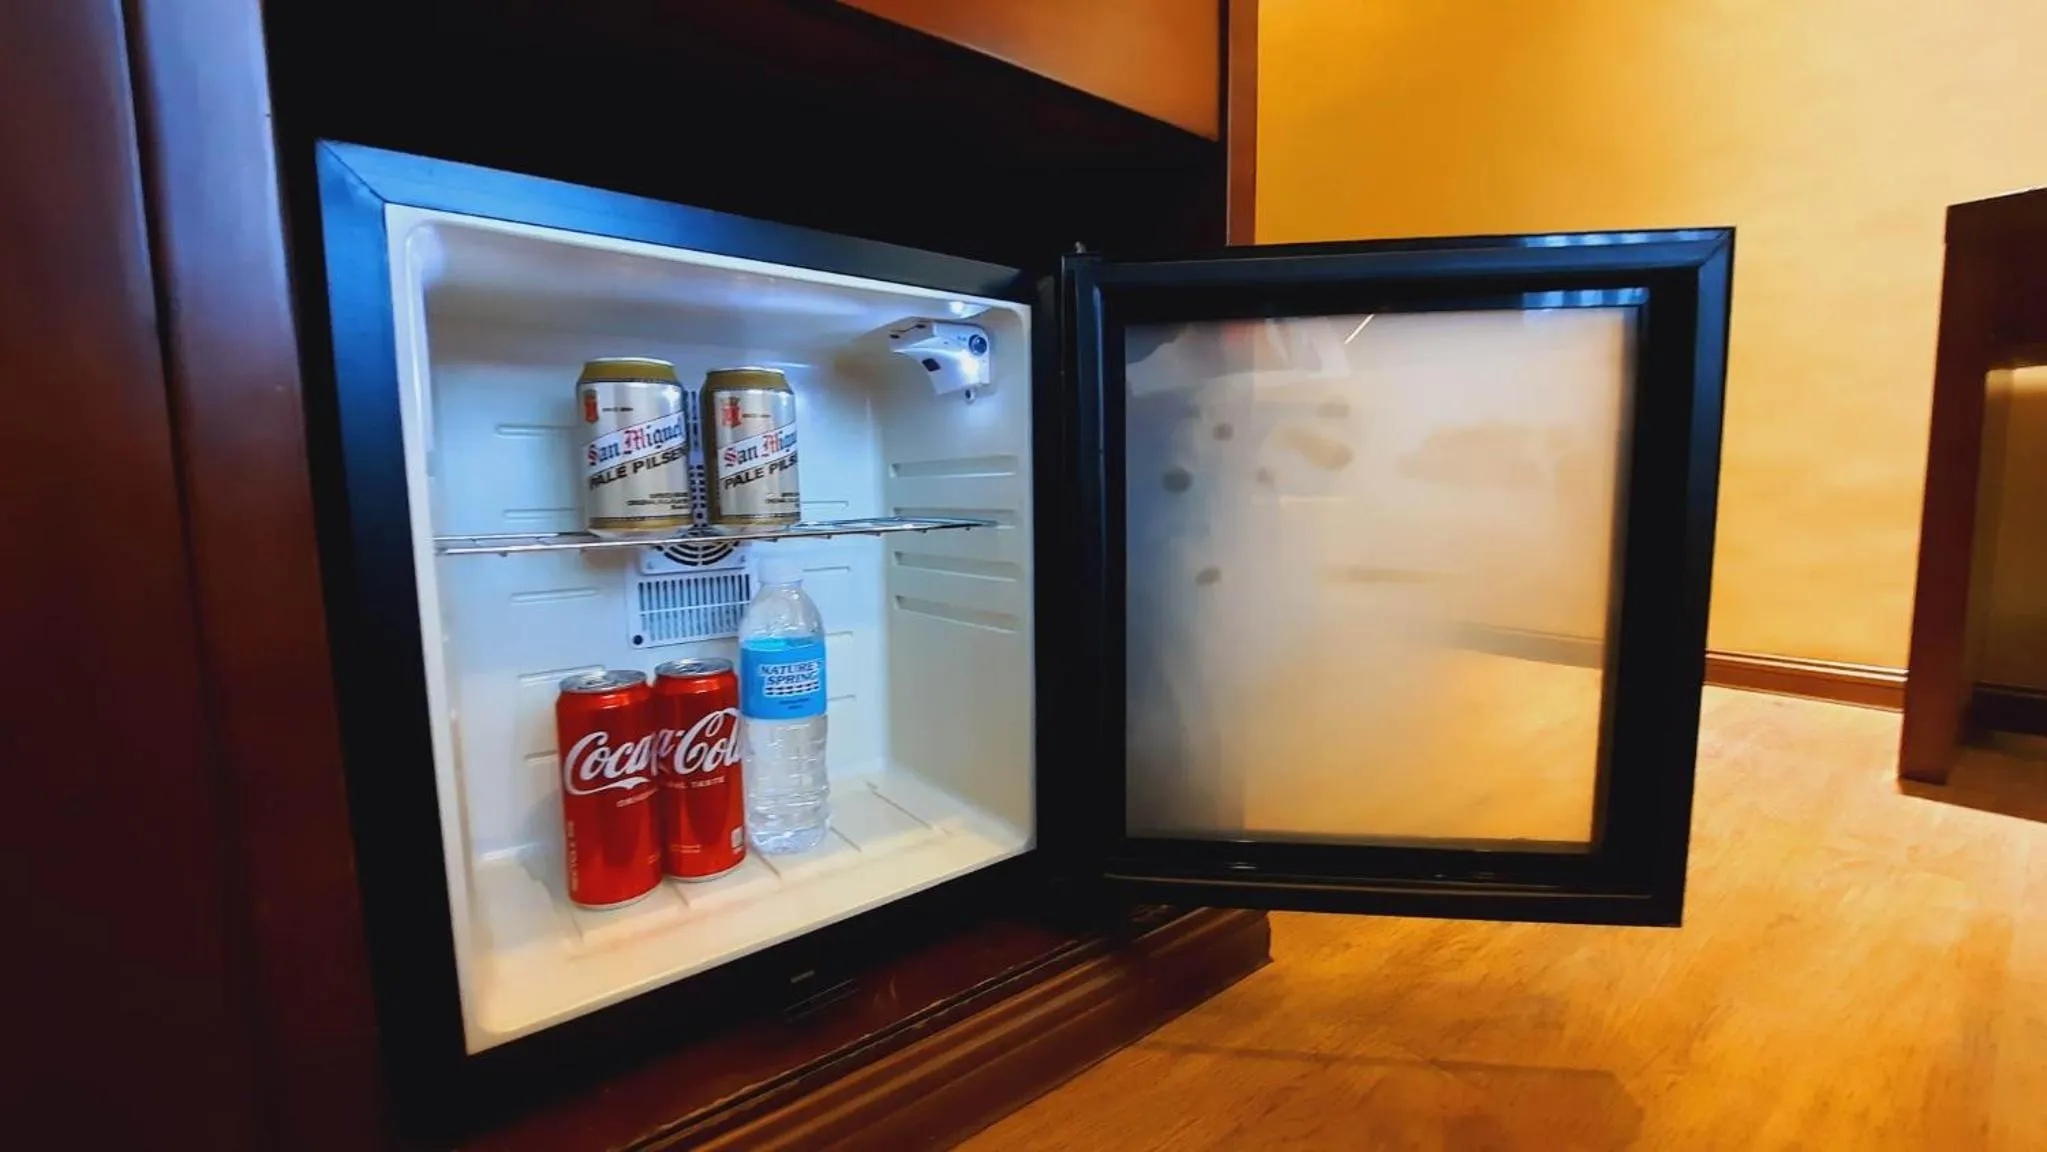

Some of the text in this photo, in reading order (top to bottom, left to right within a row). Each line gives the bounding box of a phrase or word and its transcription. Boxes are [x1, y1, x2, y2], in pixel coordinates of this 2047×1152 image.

[588, 443, 620, 466] San
[724, 447, 758, 467] San
[590, 466, 627, 491] PALE
[725, 468, 765, 489] PALE
